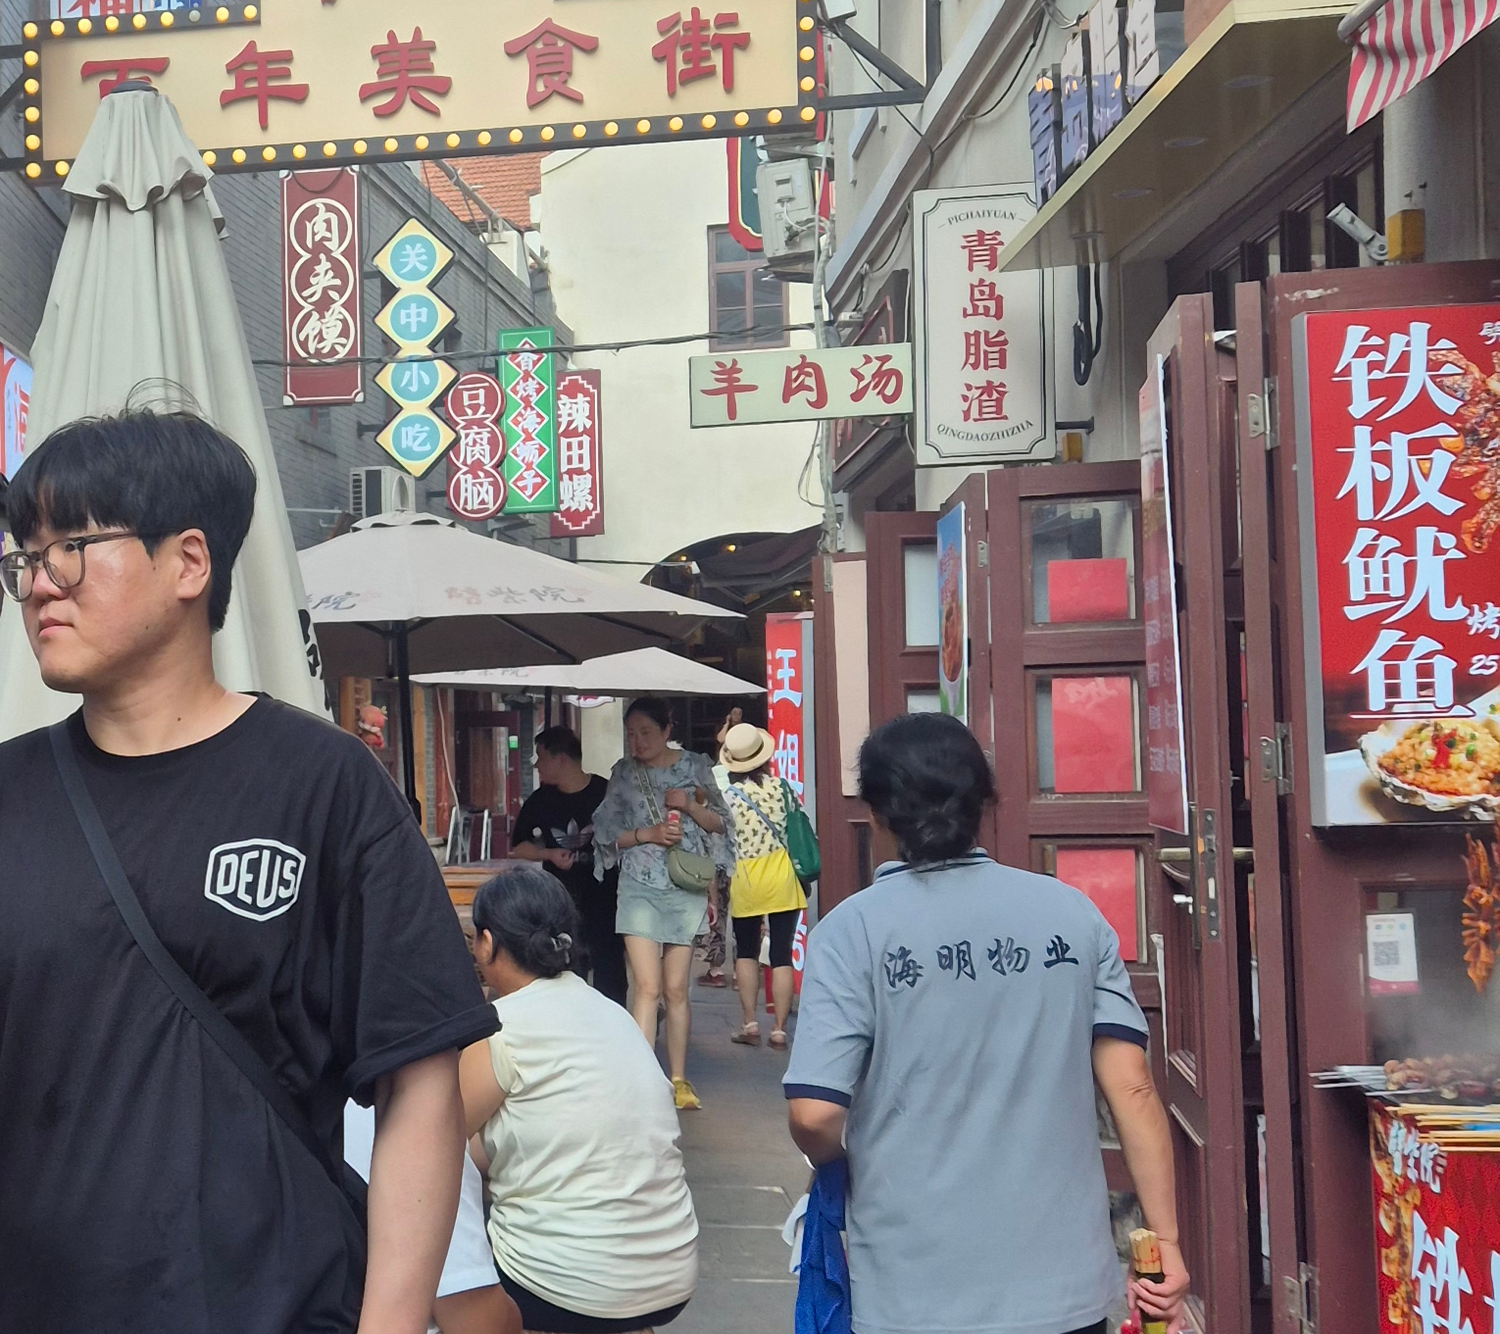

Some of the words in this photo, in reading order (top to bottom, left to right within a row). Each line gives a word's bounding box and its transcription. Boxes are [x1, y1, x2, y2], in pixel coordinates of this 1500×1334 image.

[947, 209, 1018, 225] PICHAIYUAN
[299, 203, 351, 357] 肉夹馍
[960, 229, 1009, 423] 青岛脂渣
[399, 242, 432, 453] 关中小吃
[700, 353, 904, 421] 羊肉汤
[458, 381, 504, 512] 豆腐脑
[557, 394, 594, 513] 辣田螺
[937, 419, 1034, 442] QINGDAOZHIZHA
[1332, 321, 1478, 720] 铁板鱿鱼
[216, 849, 297, 908] DEUS
[884, 934, 1080, 989] 海明物业
